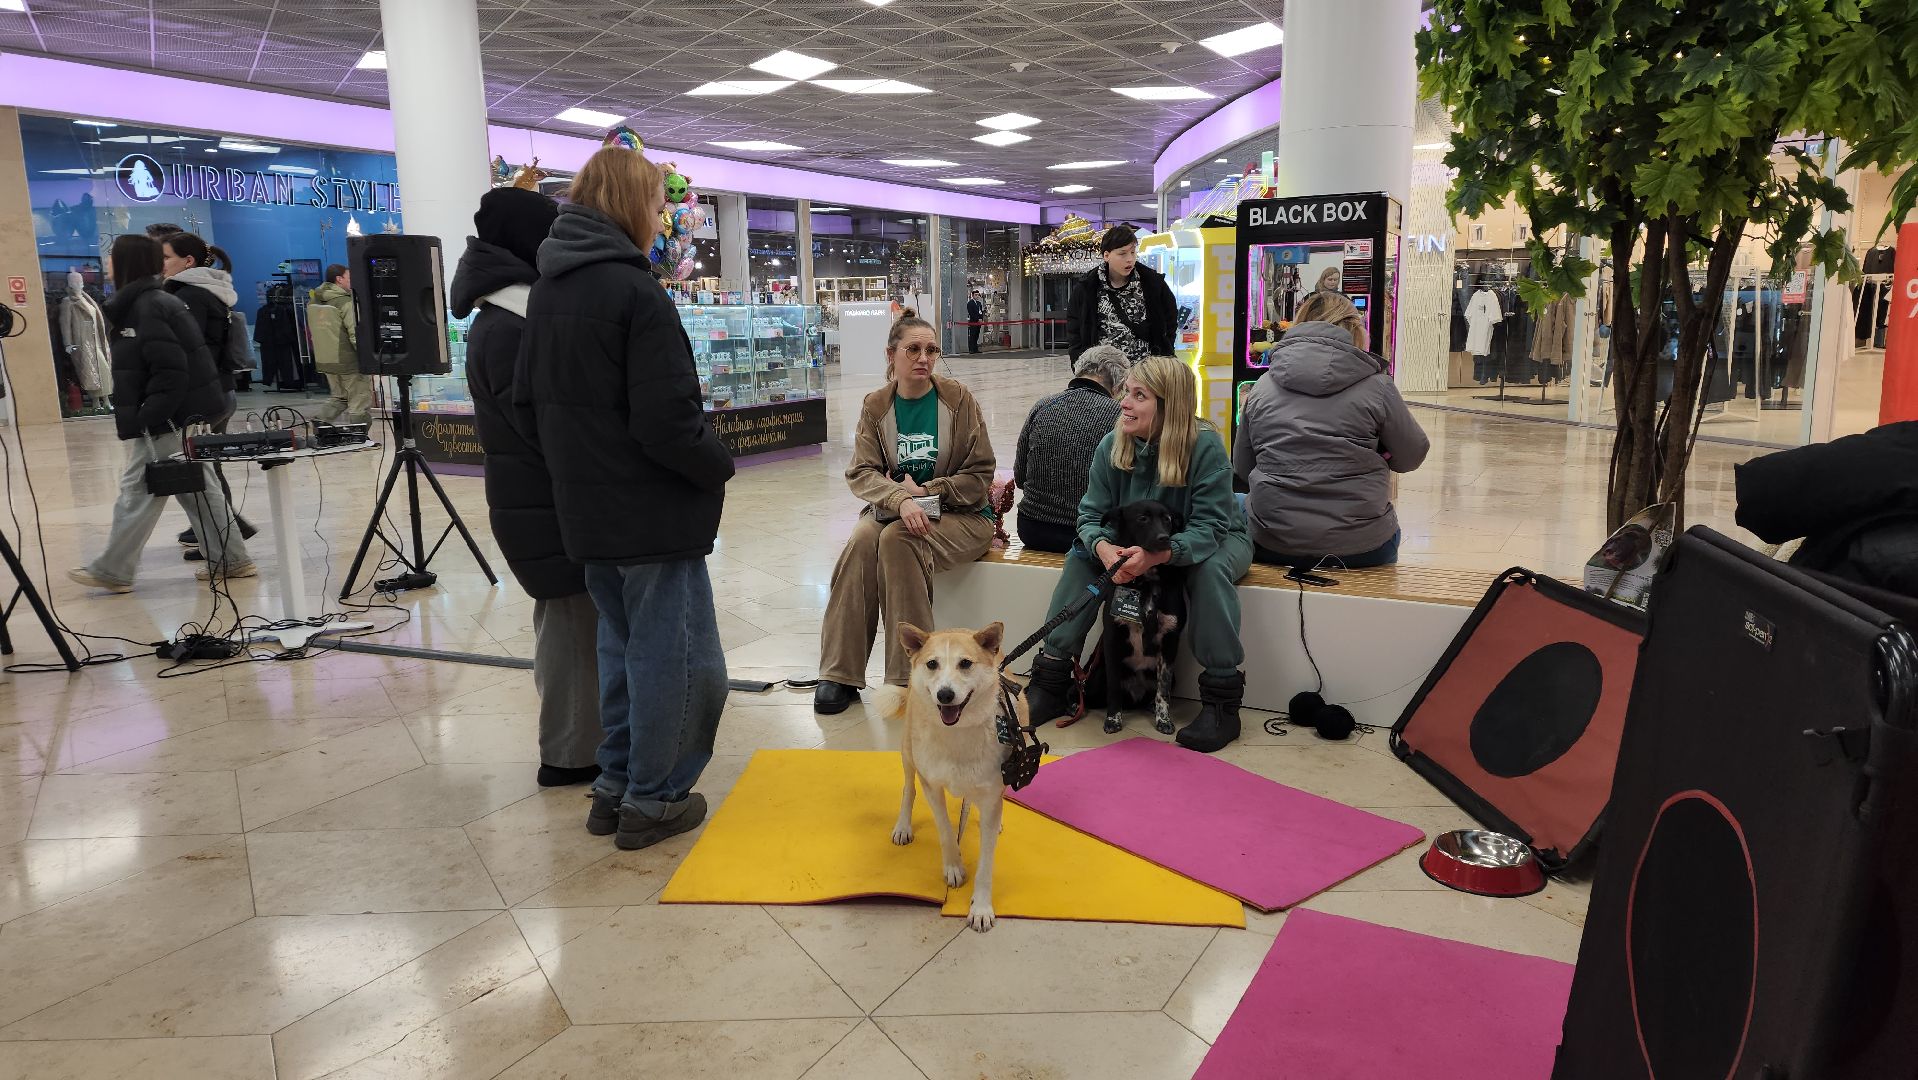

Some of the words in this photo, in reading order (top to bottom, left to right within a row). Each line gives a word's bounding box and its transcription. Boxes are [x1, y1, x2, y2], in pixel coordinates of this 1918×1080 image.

[172, 163, 295, 207] URBAN
[1249, 203, 1318, 227] BLACK
[1323, 200, 1368, 223] BOX
[422, 415, 475, 443] Ароматы
